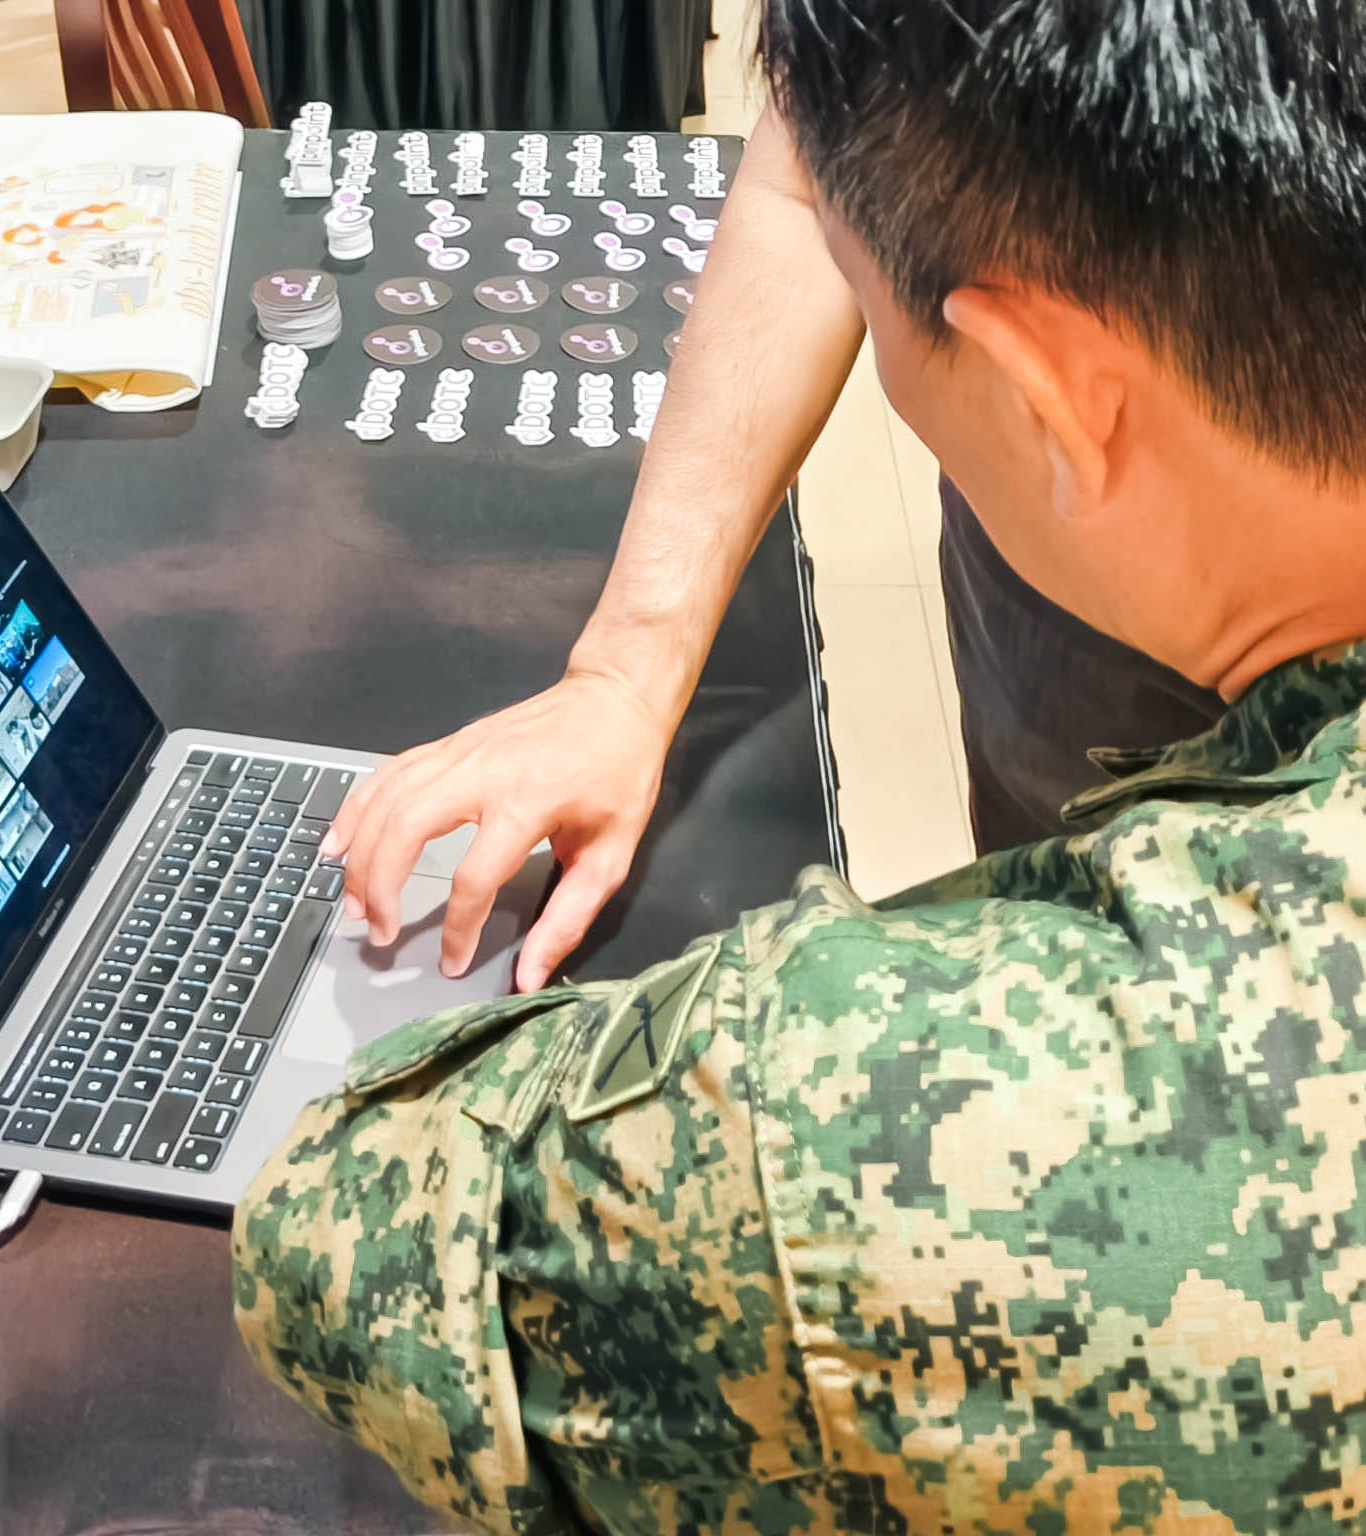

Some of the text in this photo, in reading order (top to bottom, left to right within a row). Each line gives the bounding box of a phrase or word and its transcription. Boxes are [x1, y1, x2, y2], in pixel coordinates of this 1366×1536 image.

[519, 135, 550, 195] pinpoint
[573, 135, 604, 195] pinpoint
[630, 135, 663, 195] pinpoint
[265, 345, 295, 405] DOTC
[366, 371, 400, 434] DOTC
[438, 372, 470, 432] DOTC
[522, 372, 554, 435] DOTC
[583, 376, 613, 439] DOTC
